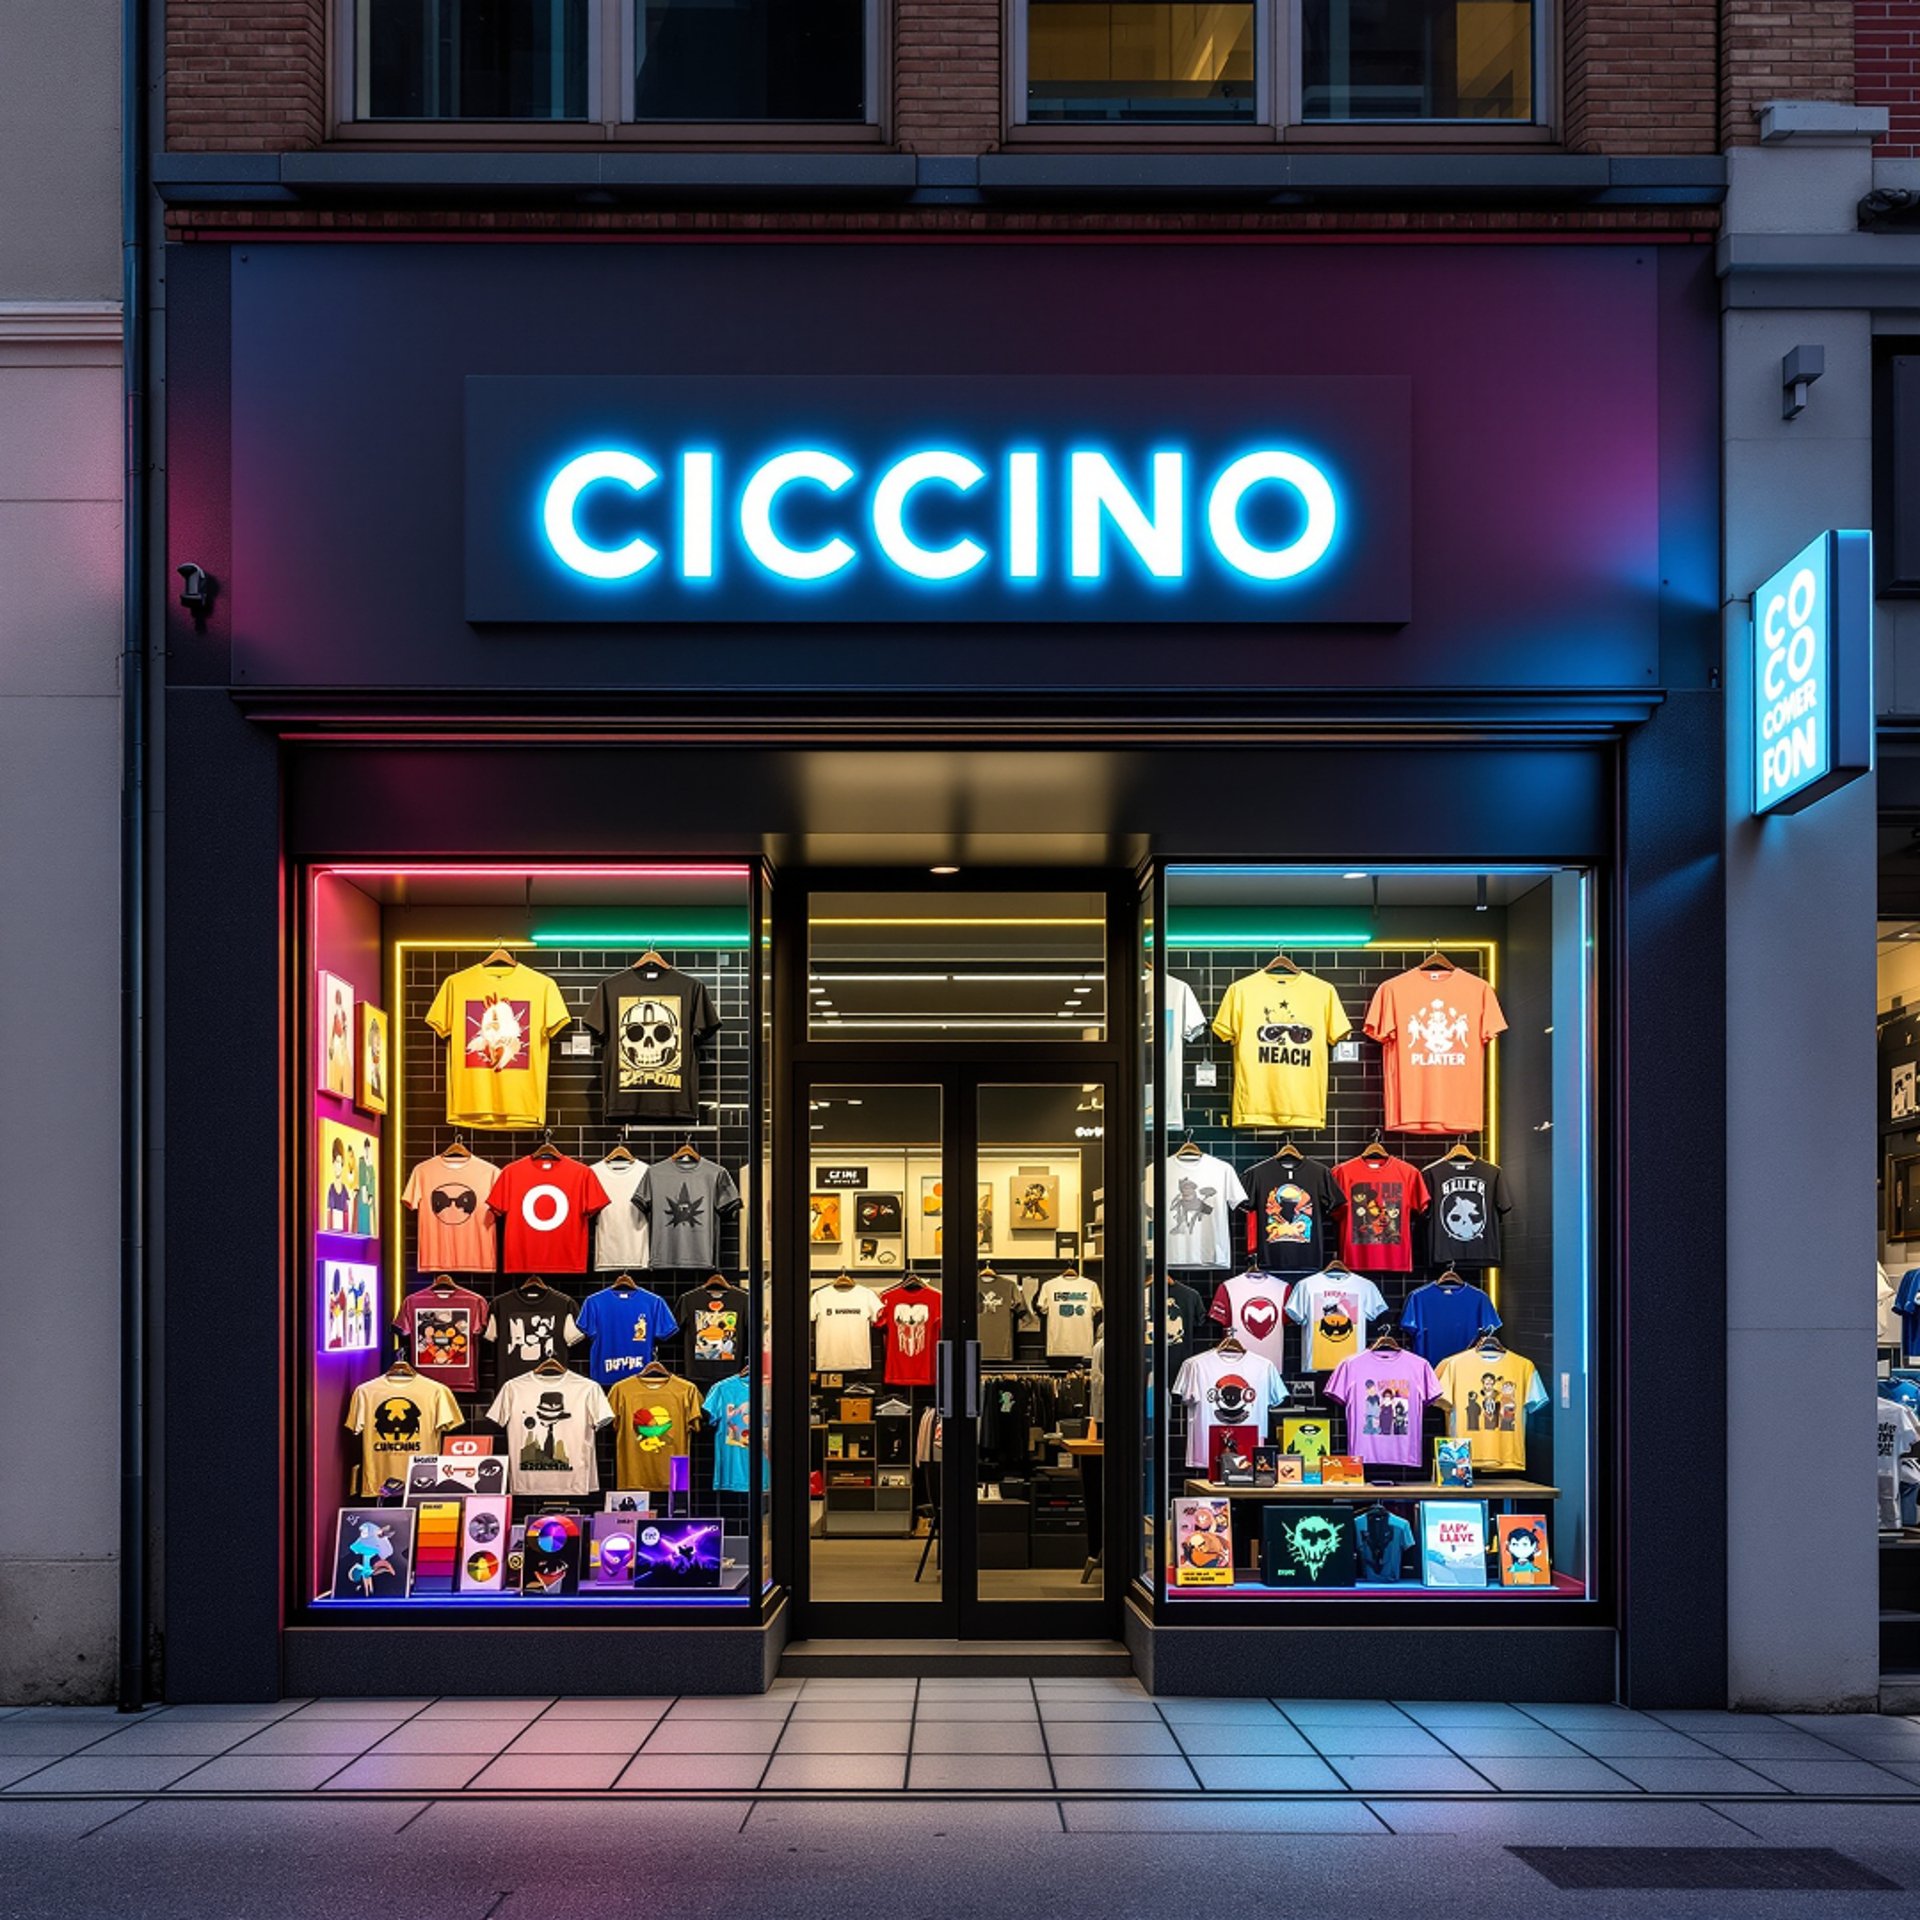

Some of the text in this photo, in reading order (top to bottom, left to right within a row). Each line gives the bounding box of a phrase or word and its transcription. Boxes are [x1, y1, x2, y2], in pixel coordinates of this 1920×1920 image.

[543, 450, 1337, 581] CICCINO
[1763, 568, 1816, 650] CO
[1763, 625, 1816, 702] CO
[1763, 716, 1816, 795] FON
[1258, 1046, 1311, 1067] NEACH
[451, 1441, 478, 1455] CD
